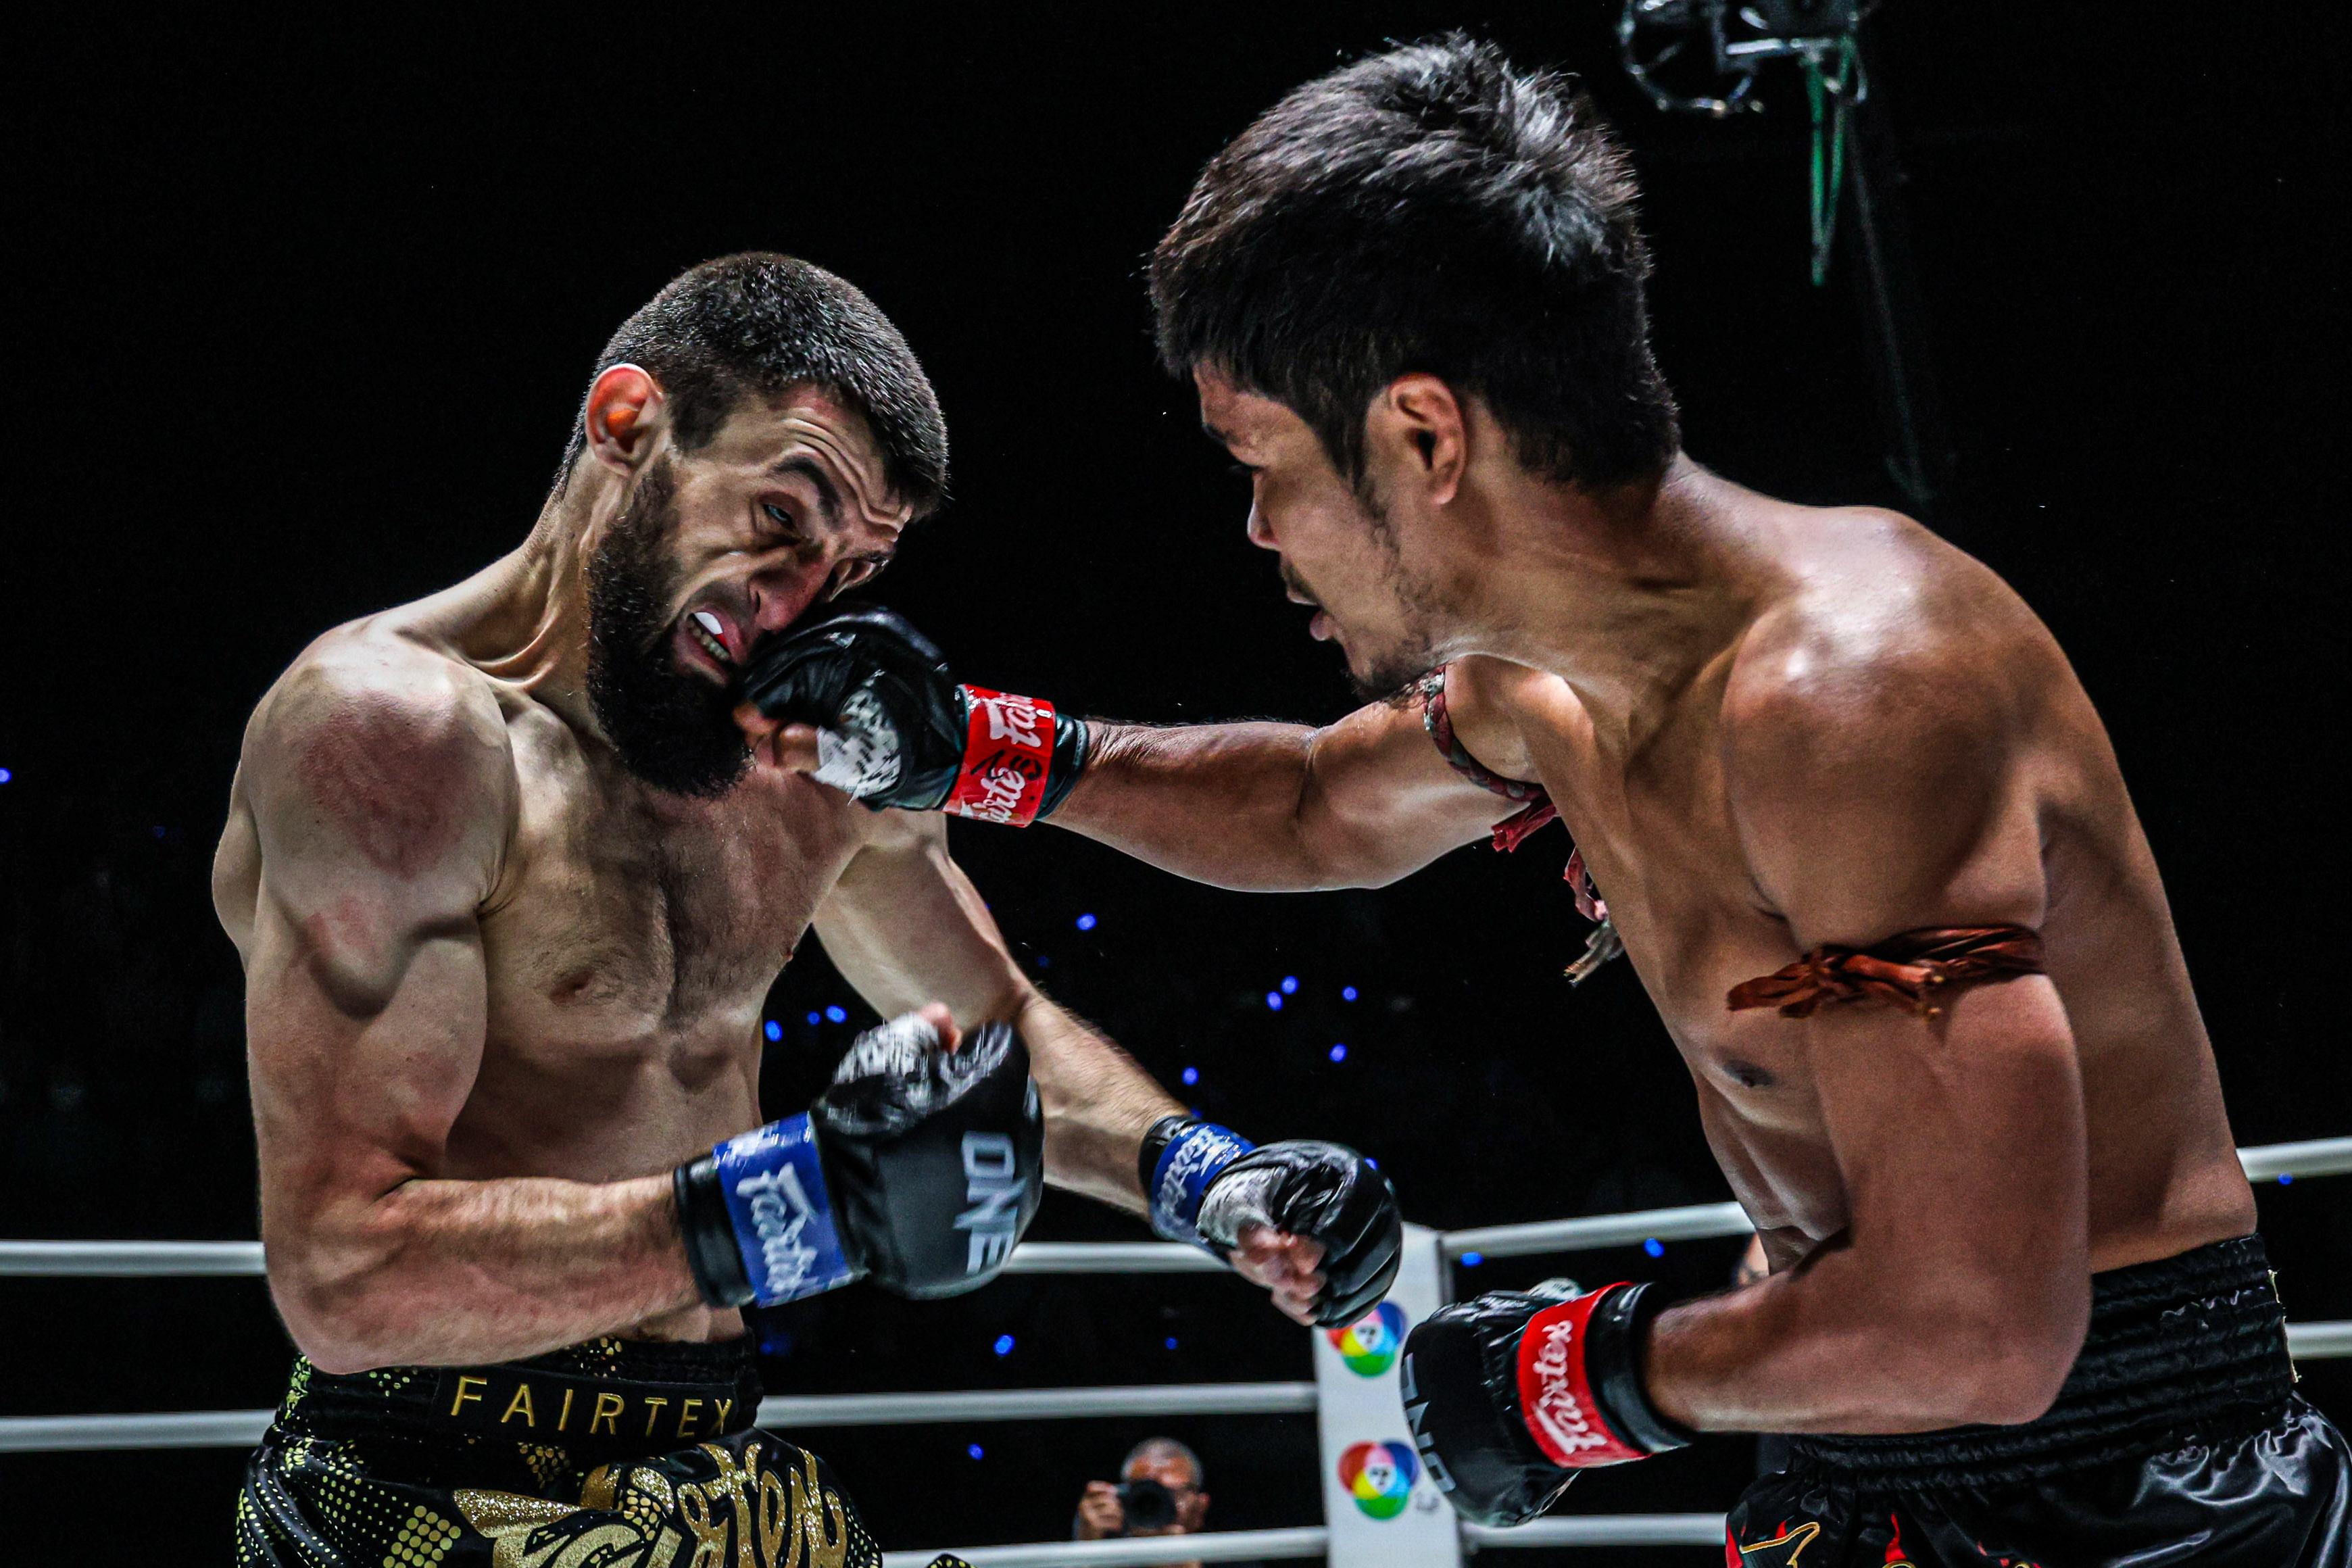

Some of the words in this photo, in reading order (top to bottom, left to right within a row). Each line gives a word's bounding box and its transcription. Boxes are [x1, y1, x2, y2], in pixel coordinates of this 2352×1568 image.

[953, 1131, 1028, 1274] ONE
[450, 1375, 733, 1438] FAIRTEX
[1529, 1319, 1608, 1455] Fairtex
